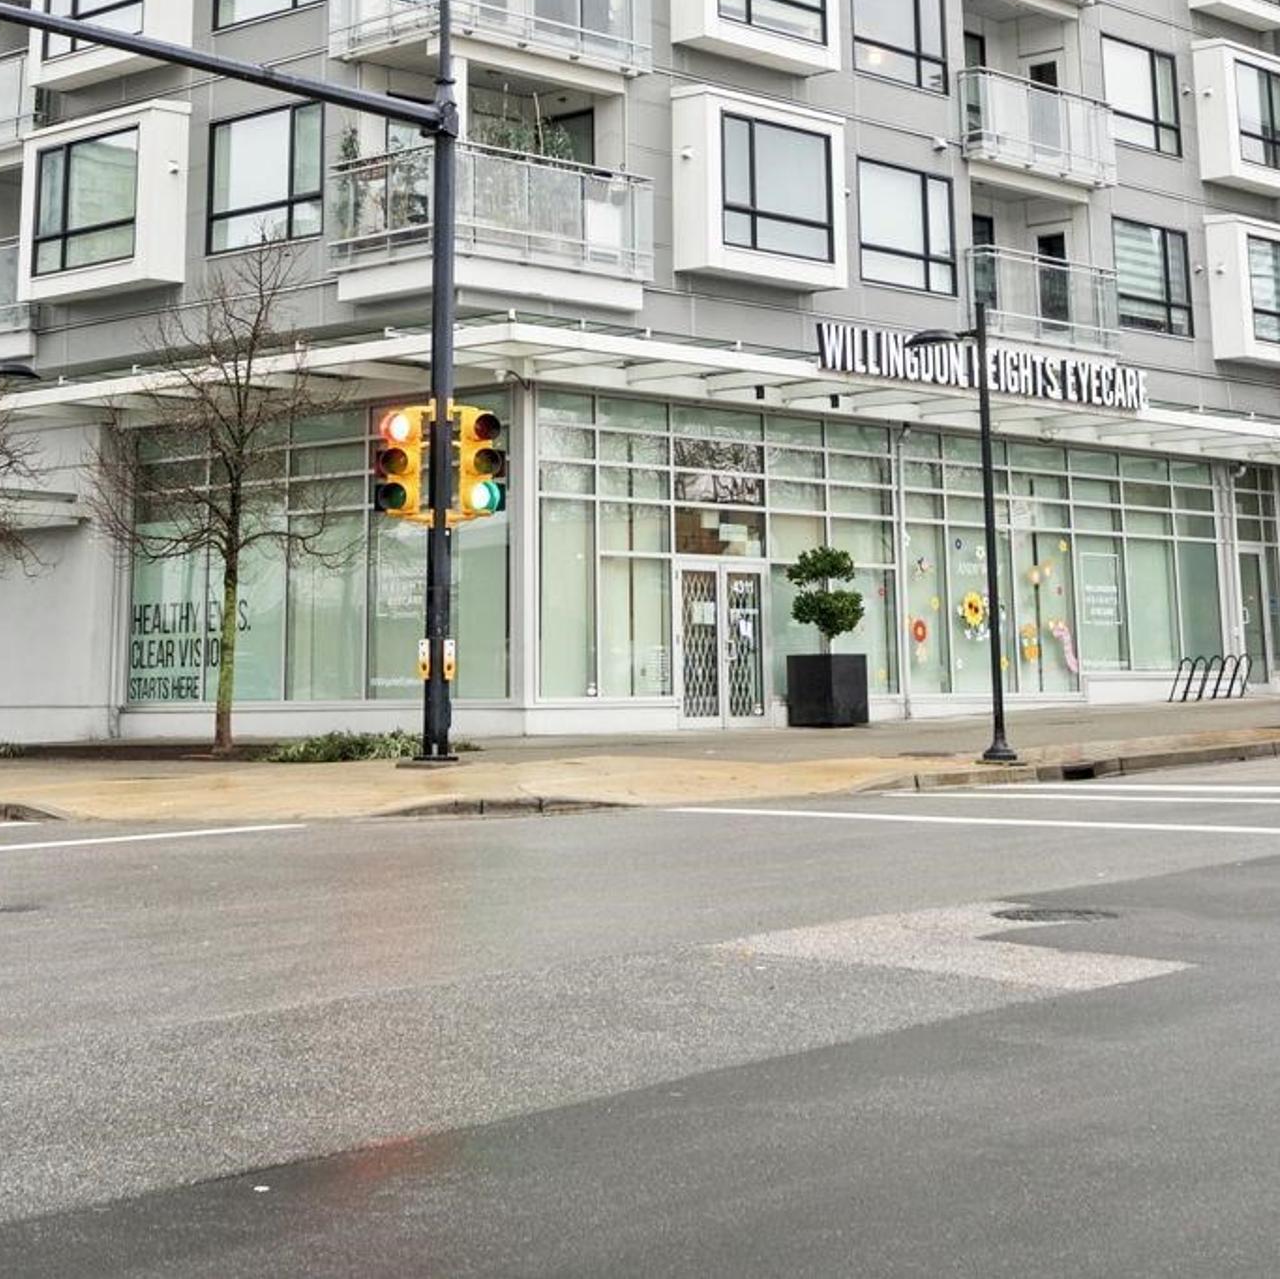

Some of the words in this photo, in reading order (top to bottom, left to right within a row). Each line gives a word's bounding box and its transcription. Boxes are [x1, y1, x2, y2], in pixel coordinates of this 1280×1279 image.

[1067, 358, 1150, 412] EYECARE
[132, 602, 200, 635] HEALTHY
[207, 600, 251, 632] ES.
[131, 639, 175, 669] CLEAR
[130, 677, 170, 700] STARTS
[171, 676, 200, 700] HERE
